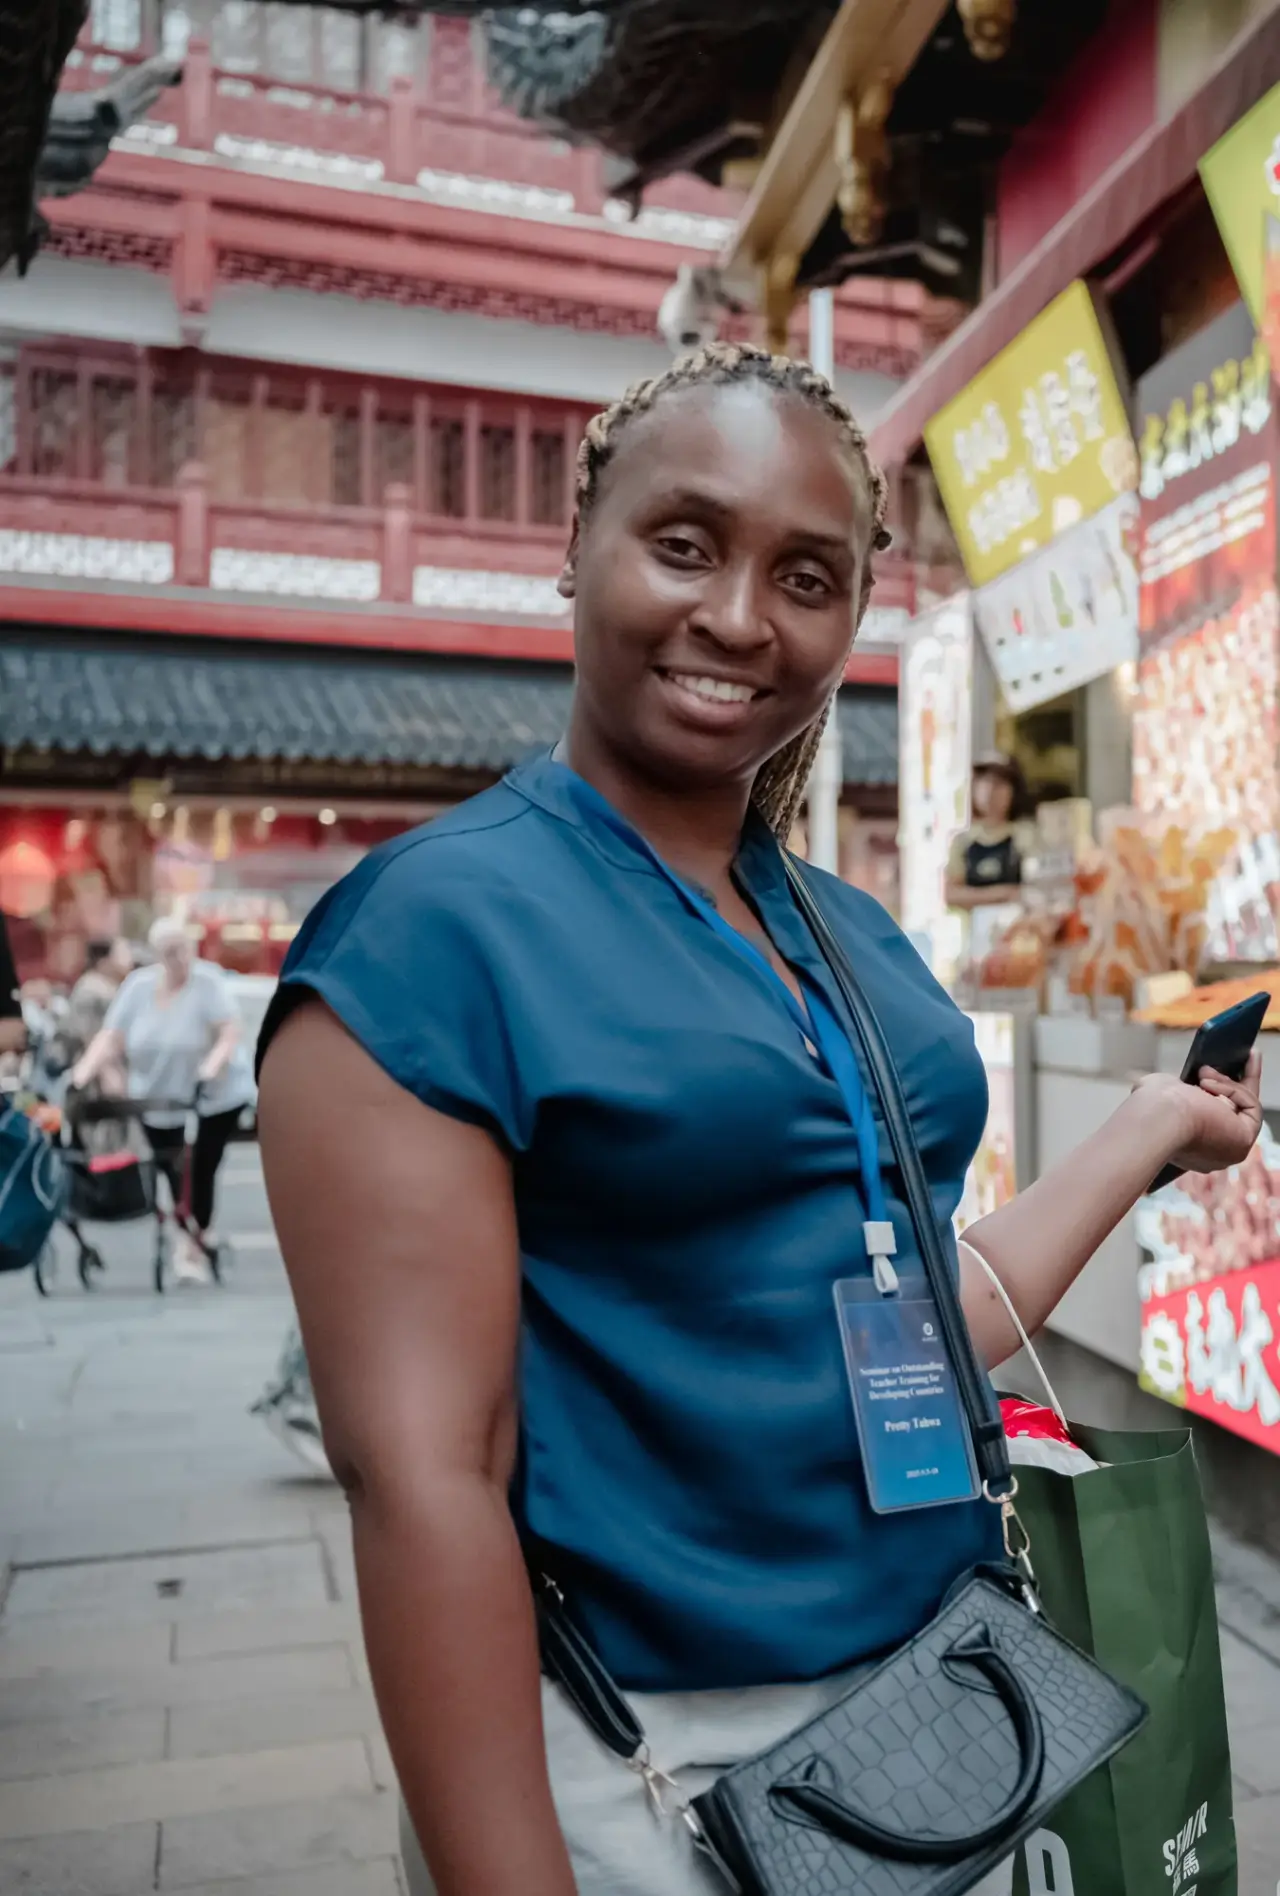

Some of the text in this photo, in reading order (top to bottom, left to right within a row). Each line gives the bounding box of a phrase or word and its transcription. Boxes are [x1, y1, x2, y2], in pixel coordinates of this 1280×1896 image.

[870, 1373, 940, 1387] Teacher Training for
[869, 1385, 944, 1399] Developing Countries
[1162, 1800, 1208, 1877] SEMIR
